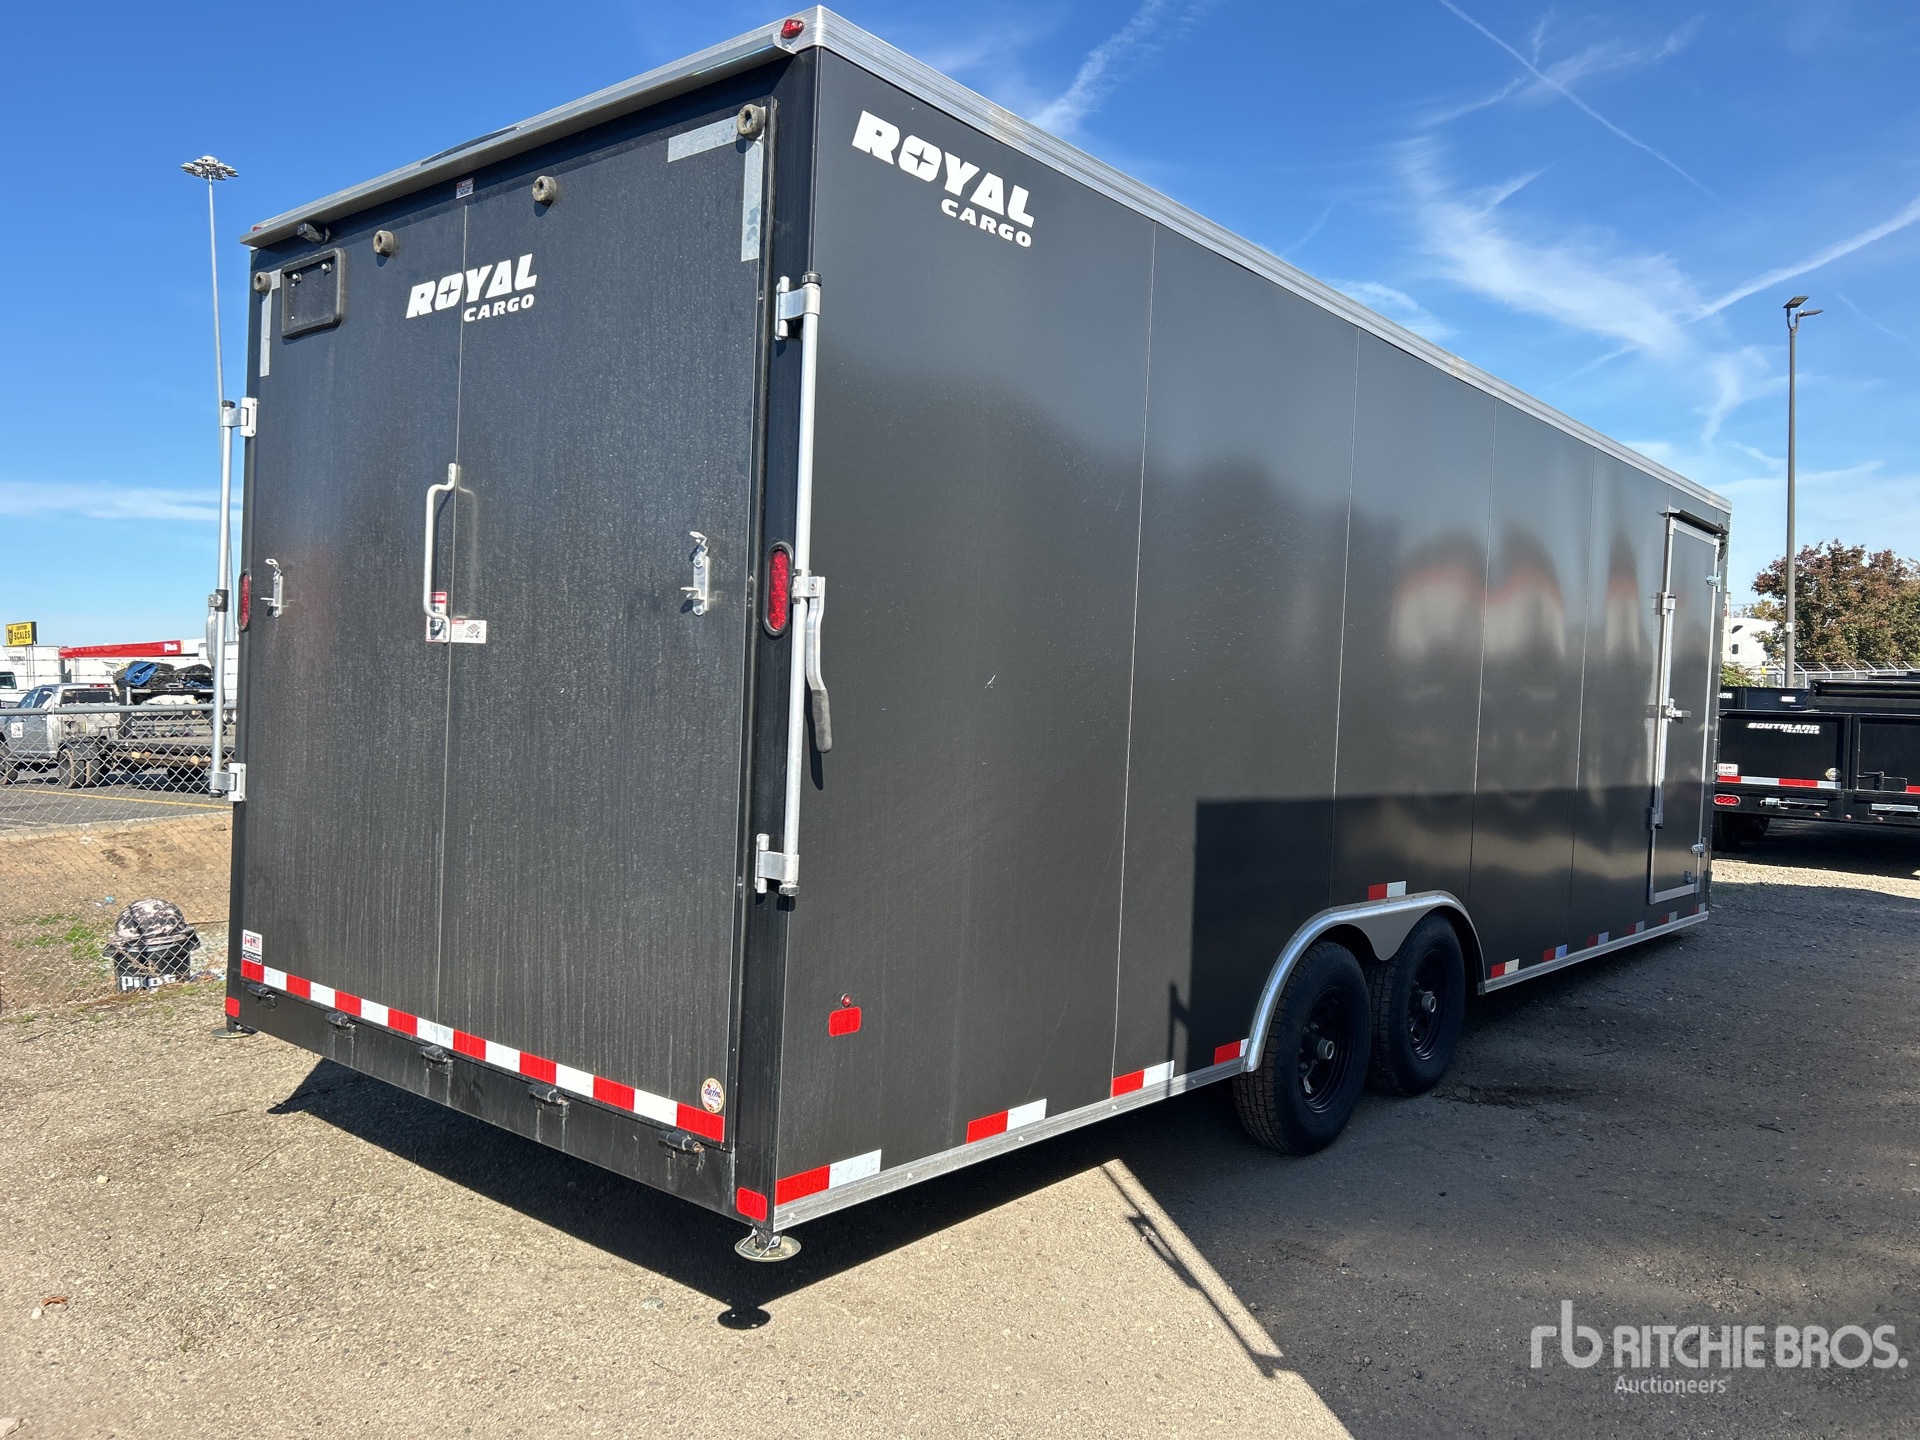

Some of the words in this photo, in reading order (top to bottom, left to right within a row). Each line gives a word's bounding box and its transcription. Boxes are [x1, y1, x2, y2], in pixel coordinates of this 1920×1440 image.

[851, 110, 1035, 228] ROYAL
[941, 198, 1032, 248] CARGO
[405, 253, 538, 319] ROYAL
[463, 293, 535, 323] CARGO
[14, 631, 30, 640] SCALES
[1747, 722, 1820, 731] SOUTHLAND
